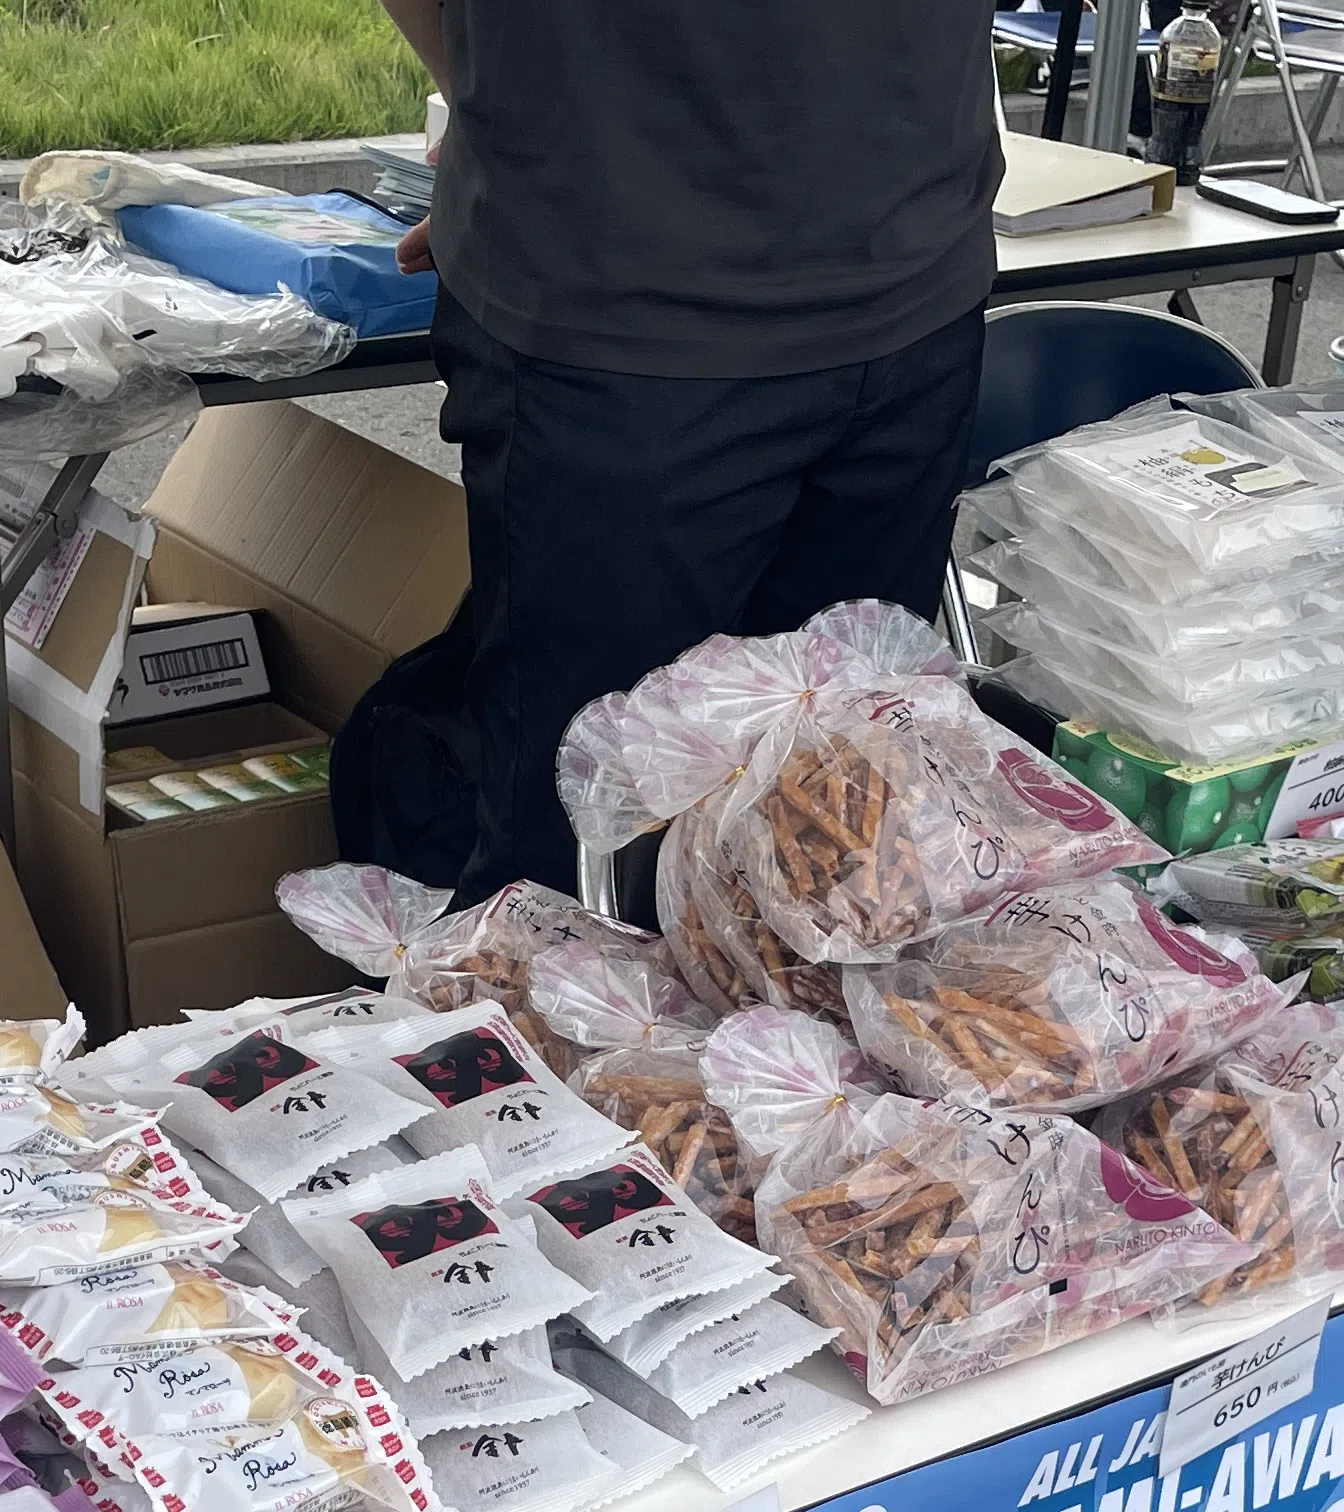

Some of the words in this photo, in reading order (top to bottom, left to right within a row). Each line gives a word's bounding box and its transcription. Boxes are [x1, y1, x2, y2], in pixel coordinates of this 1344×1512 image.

[1113, 1225, 1168, 1258] NARUTO
[117, 1295, 145, 1309] ROSA
[159, 1361, 212, 1399] Rosa
[1211, 1336, 1286, 1390] 芋けんぴ
[204, 1401, 225, 1417] ROSA
[1213, 1385, 1262, 1428] 650
[1267, 1380, 1279, 1397] 円
[242, 1451, 298, 1492] Rosa
[1017, 1435, 1099, 1508] ALL
[285, 1486, 314, 1508] ROSA
